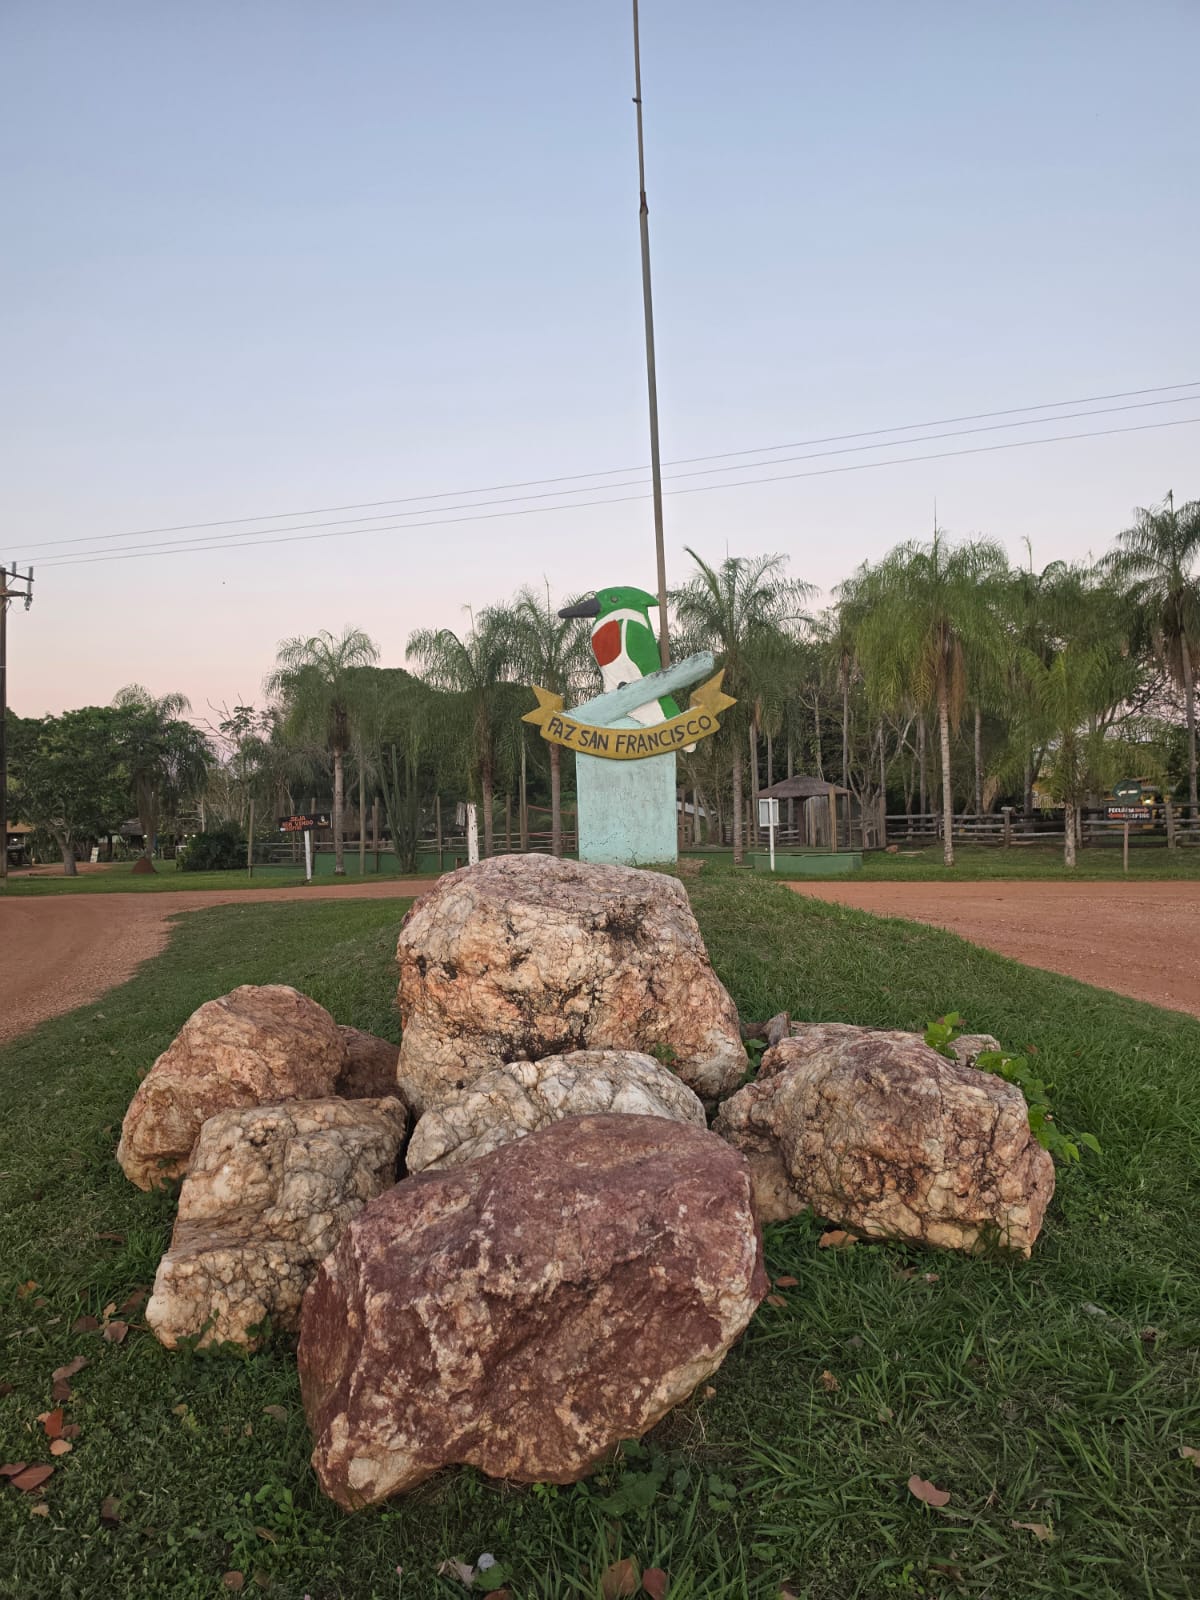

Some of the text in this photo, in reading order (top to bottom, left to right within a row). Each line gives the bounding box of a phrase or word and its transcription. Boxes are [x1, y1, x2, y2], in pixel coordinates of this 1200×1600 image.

[547, 715, 712, 753] FAZ SAN FRANCISCO
